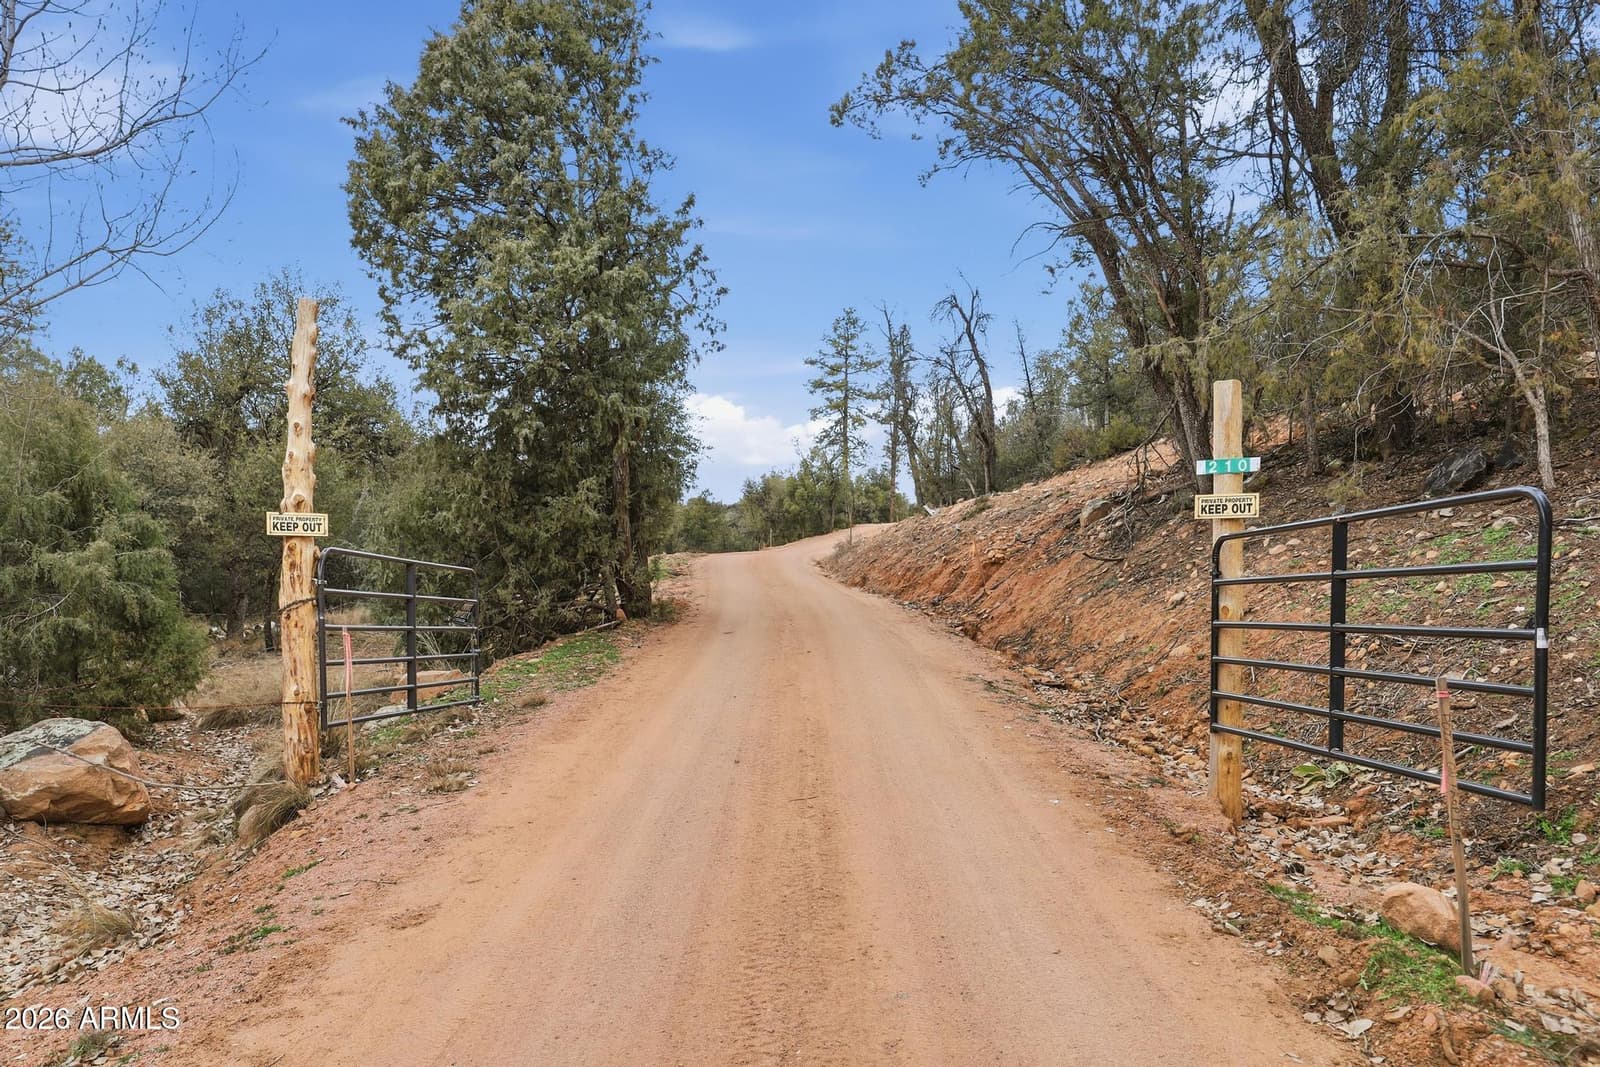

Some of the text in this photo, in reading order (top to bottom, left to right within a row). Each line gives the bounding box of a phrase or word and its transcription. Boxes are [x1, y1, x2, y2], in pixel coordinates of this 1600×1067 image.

[1209, 459, 1247, 473] 210
[1200, 503, 1253, 515] KEEP OUT
[272, 521, 323, 532] KEEP OUT
